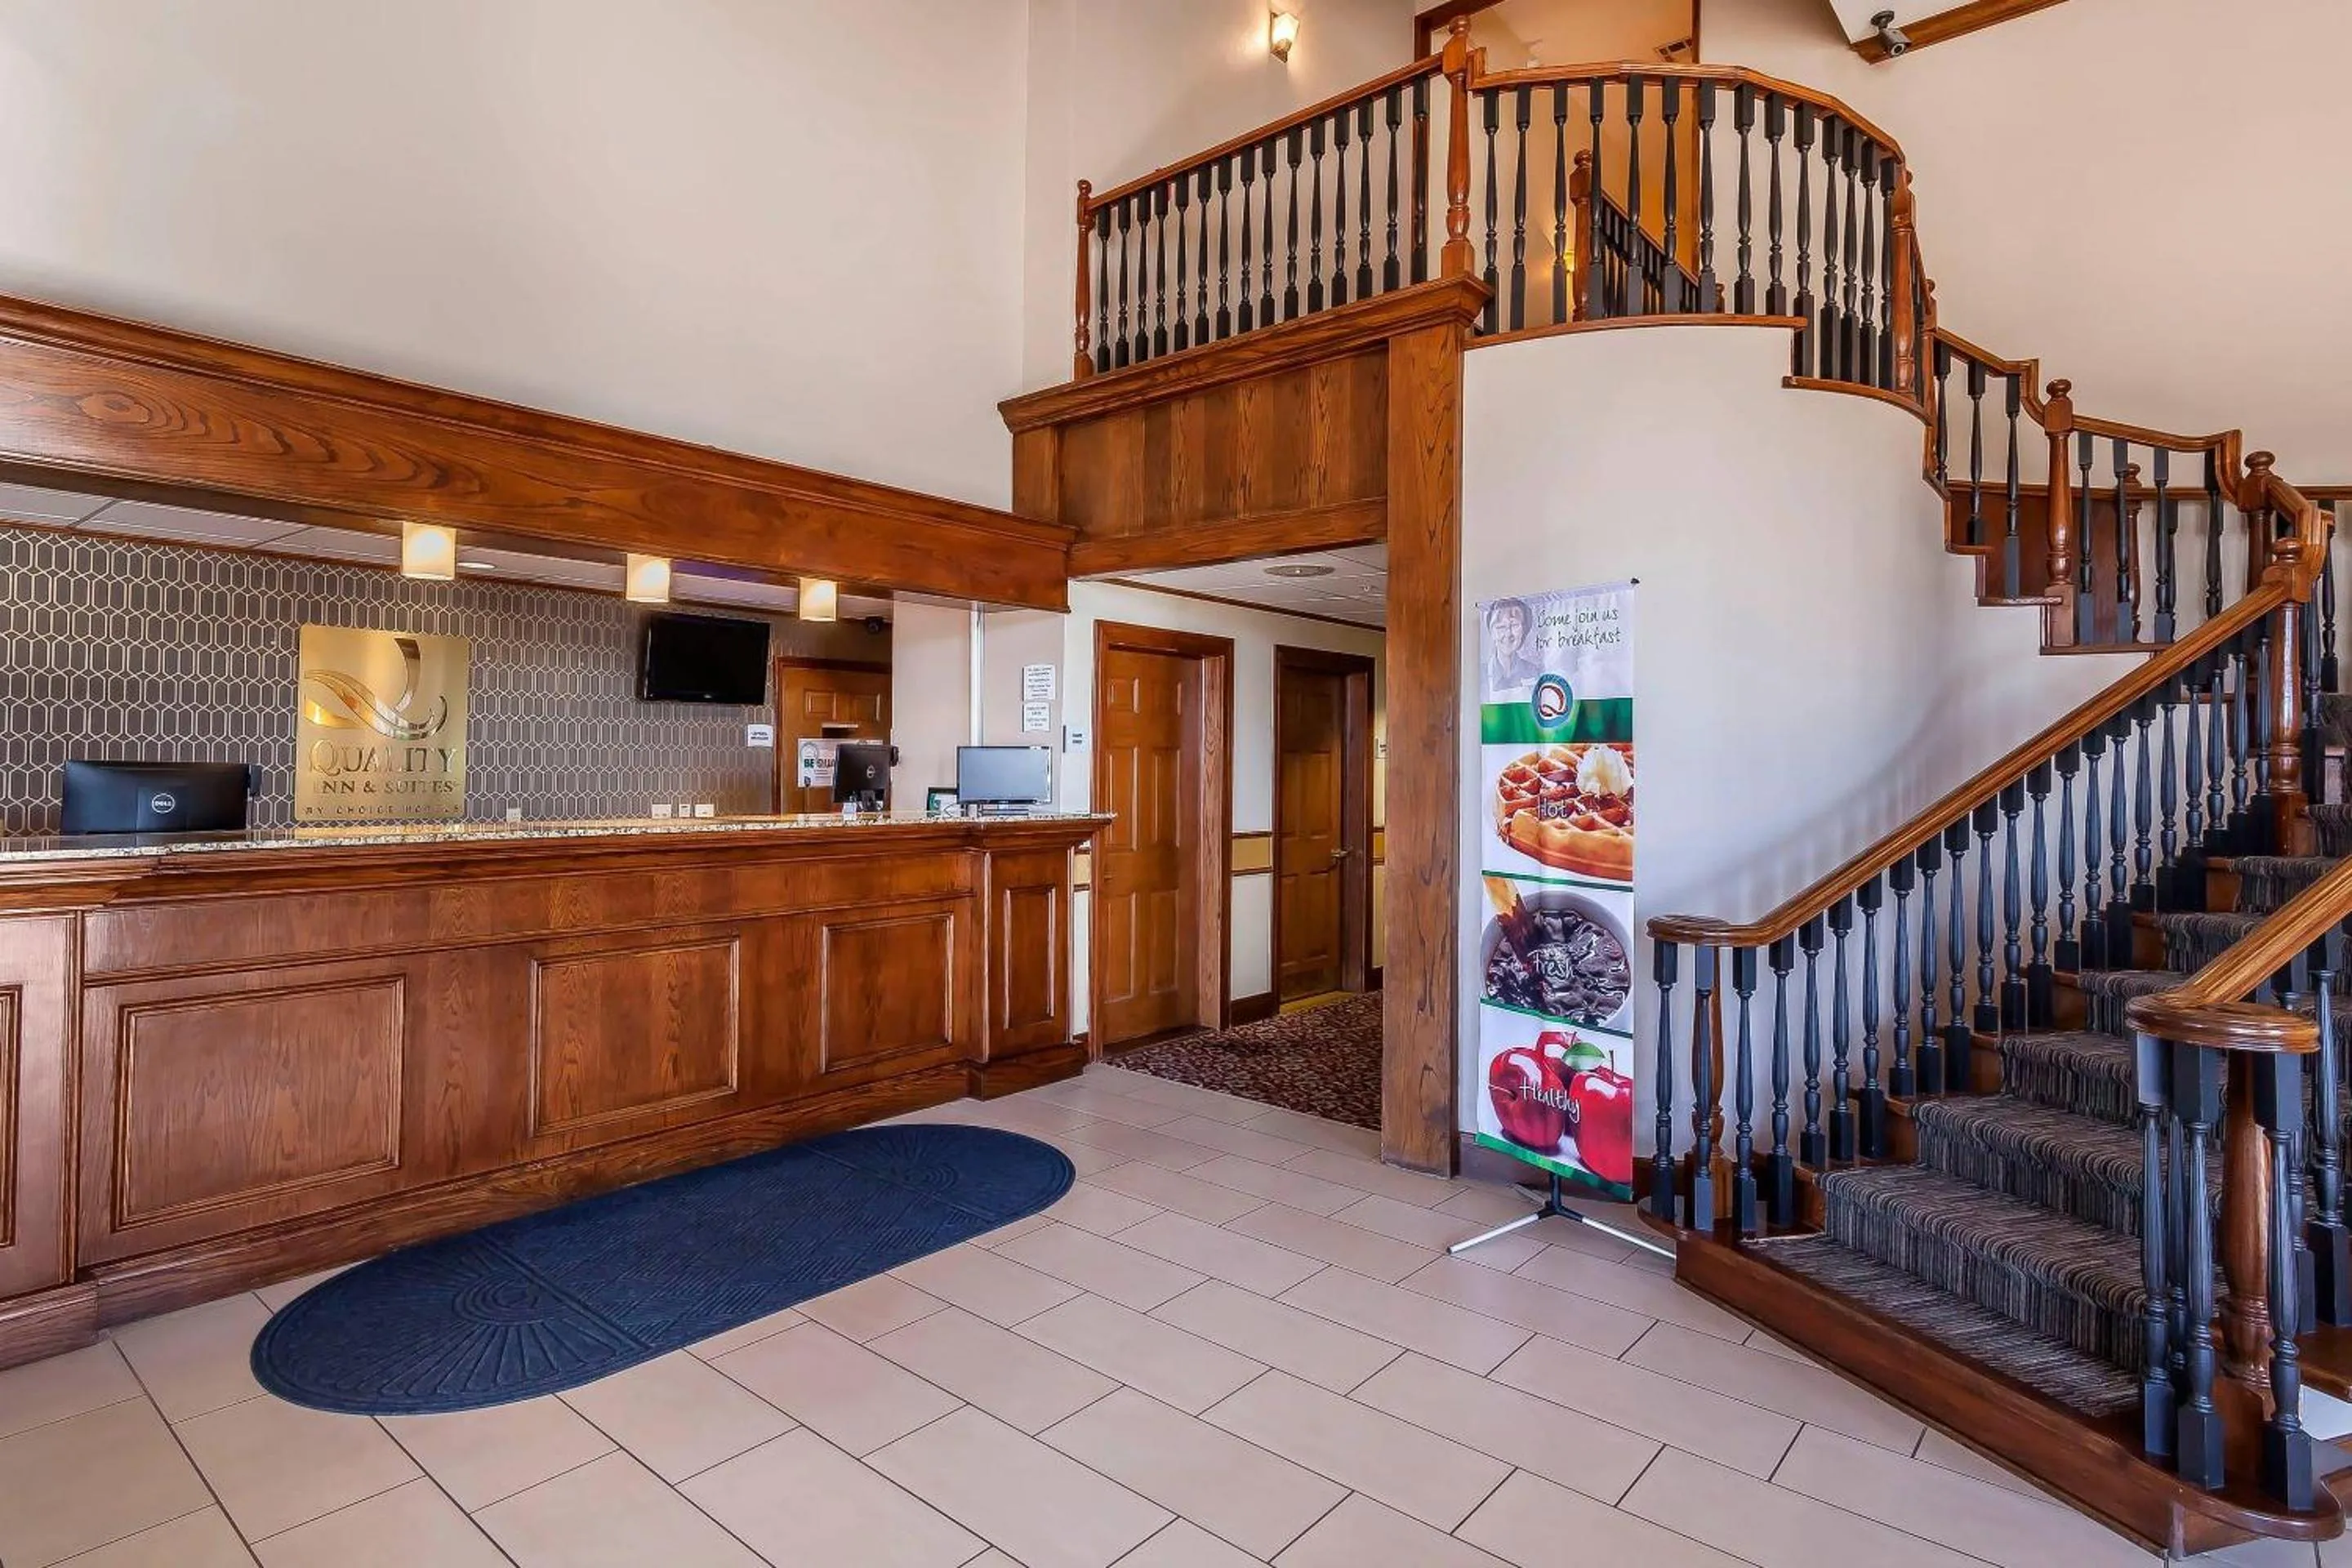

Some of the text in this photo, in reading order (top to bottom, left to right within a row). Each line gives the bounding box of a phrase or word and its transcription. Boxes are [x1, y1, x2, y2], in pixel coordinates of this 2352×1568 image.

[1538, 607, 1619, 632] Come join us
[1535, 626, 1620, 652] for breakfast
[310, 738, 457, 776] QUALITY
[314, 779, 455, 795] INN & SUITES
[336, 805, 394, 814] CHOICE
[1537, 795, 1567, 819] Hot
[1519, 1076, 1579, 1124] Healthy
